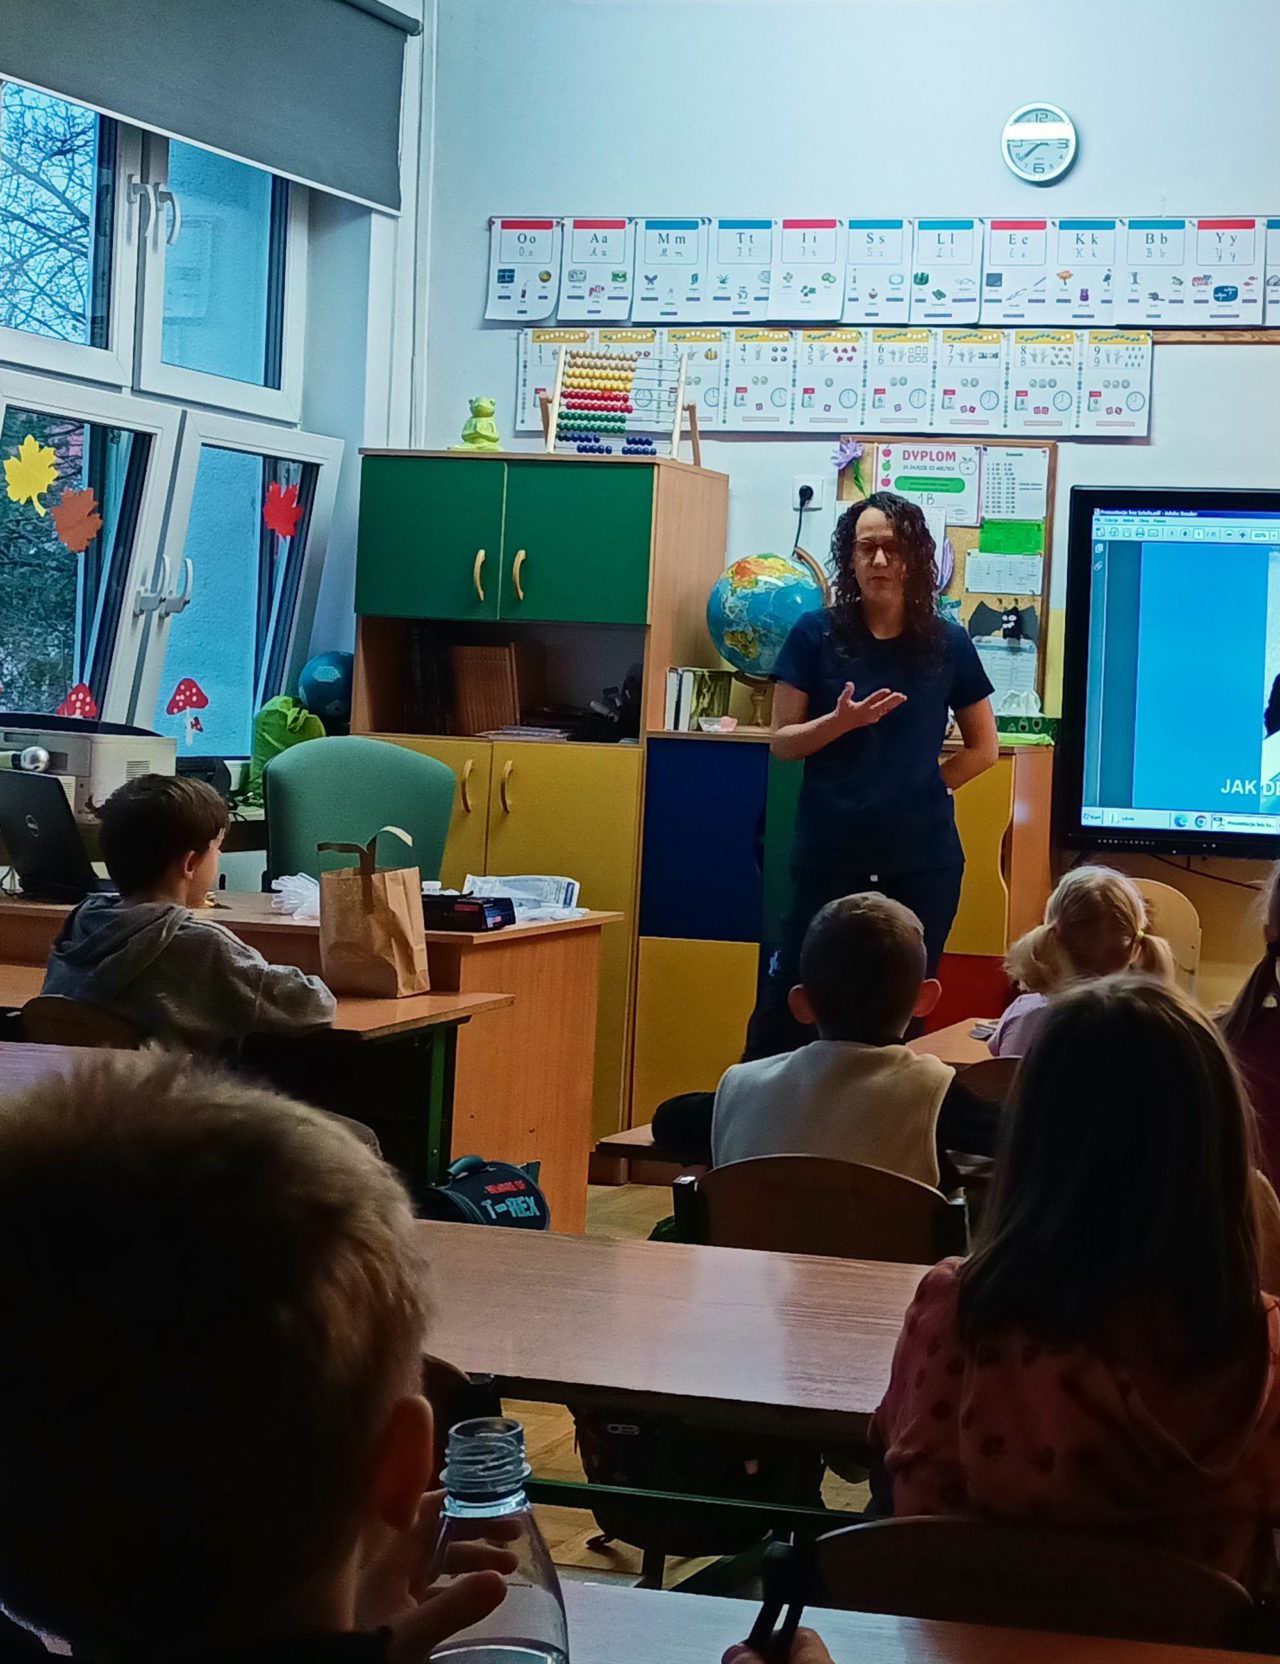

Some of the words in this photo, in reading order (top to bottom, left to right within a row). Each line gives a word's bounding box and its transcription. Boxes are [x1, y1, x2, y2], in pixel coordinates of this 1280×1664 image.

[1035, 113, 1048, 123] 12
[1056, 138, 1069, 149] 3
[1033, 163, 1045, 174] 6
[517, 232, 527, 245] O
[529, 235, 536, 244] o
[590, 233, 600, 244] A
[601, 235, 608, 244] a
[658, 232, 670, 245] M
[675, 235, 686, 245] m
[736, 232, 745, 244] T
[749, 234, 754, 244] t
[802, 232, 806, 243] I
[813, 232, 817, 243] i
[866, 232, 874, 244] S
[879, 235, 885, 244] s
[937, 233, 945, 245] L
[950, 232, 954, 245] l
[1008, 233, 1016, 245] E
[1021, 236, 1029, 245] e
[1076, 233, 1085, 245] K
[1091, 232, 1099, 245] k
[1145, 232, 1155, 244] B
[1160, 232, 1168, 244] b
[1215, 232, 1225, 243] Y
[1230, 235, 1237, 246] y
[672, 343, 679, 354] 3
[739, 344, 746, 353] 4
[808, 344, 814, 353] 5
[878, 344, 884, 354] 6
[948, 345, 955, 354] 7
[1020, 346, 1027, 355] 8
[1094, 346, 1100, 355] 9
[902, 450, 956, 462] DYPLOM
[1220, 779, 1257, 795] JAK
[481, 1196, 540, 1219] T-REX
